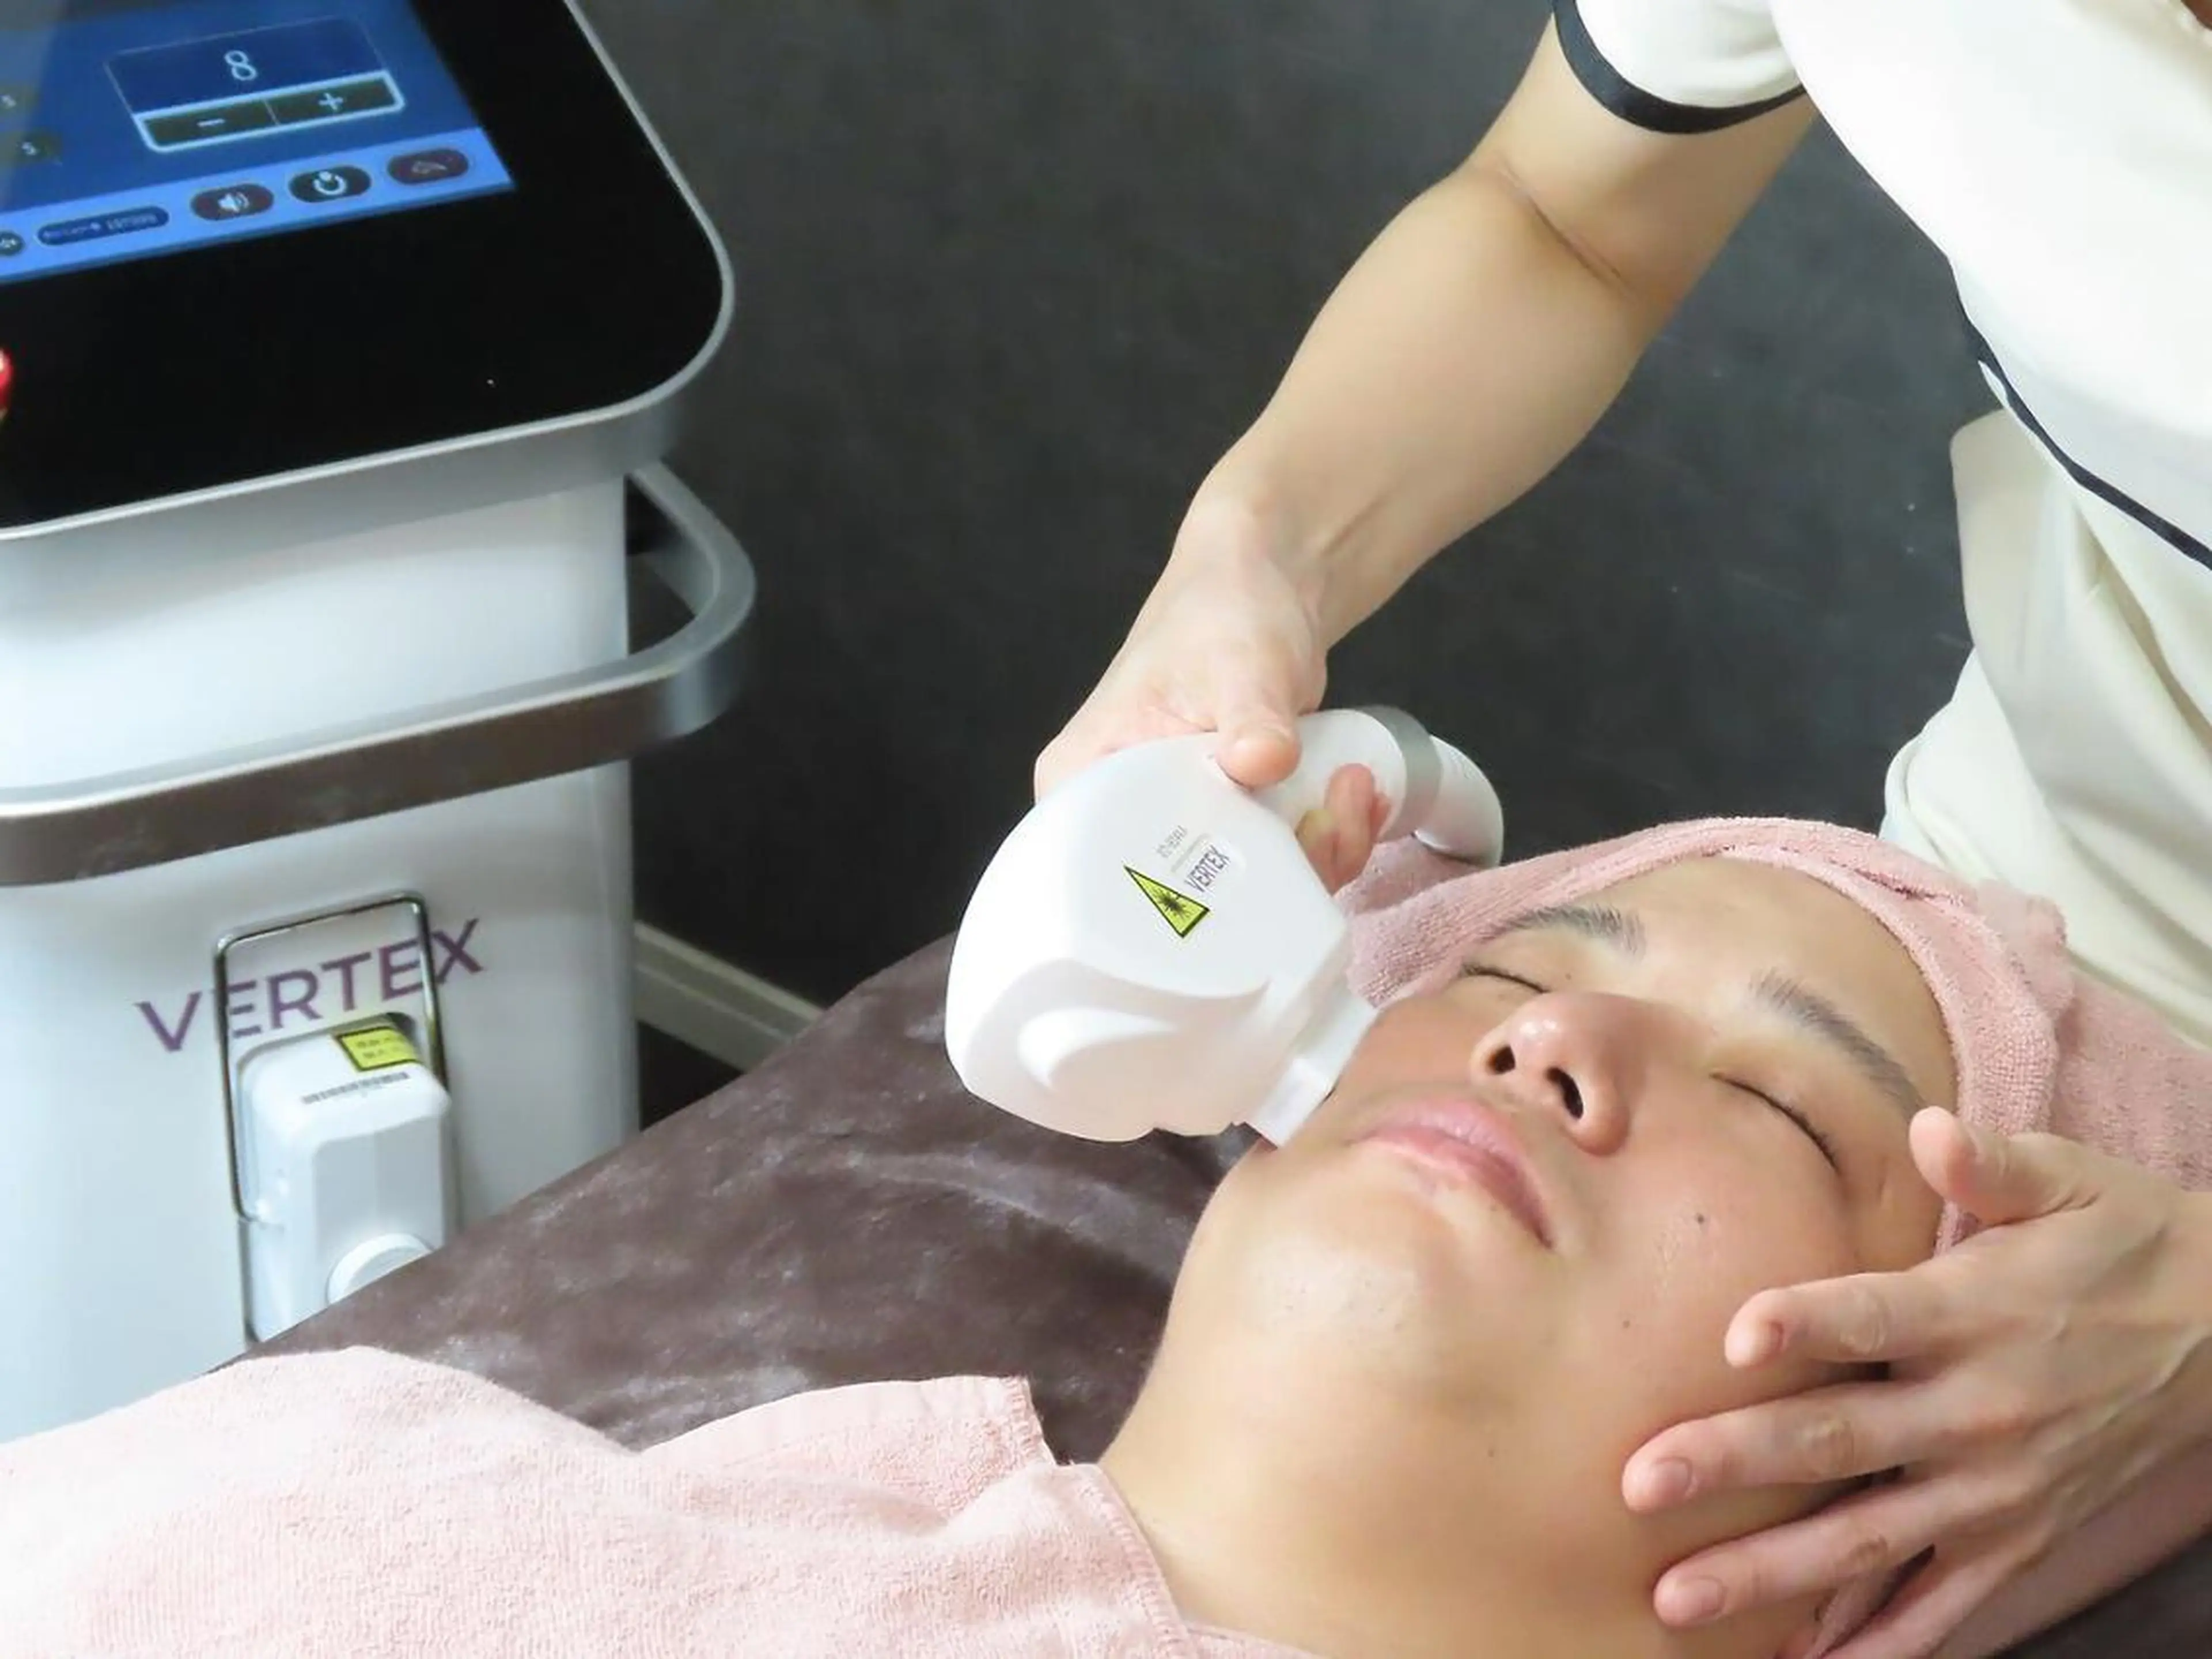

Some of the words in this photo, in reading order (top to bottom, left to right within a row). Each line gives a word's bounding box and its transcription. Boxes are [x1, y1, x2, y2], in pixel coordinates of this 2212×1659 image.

[224, 50, 257, 81] 8
[1184, 844, 1231, 892] VERTEX
[135, 919, 483, 1051] VERTEX
